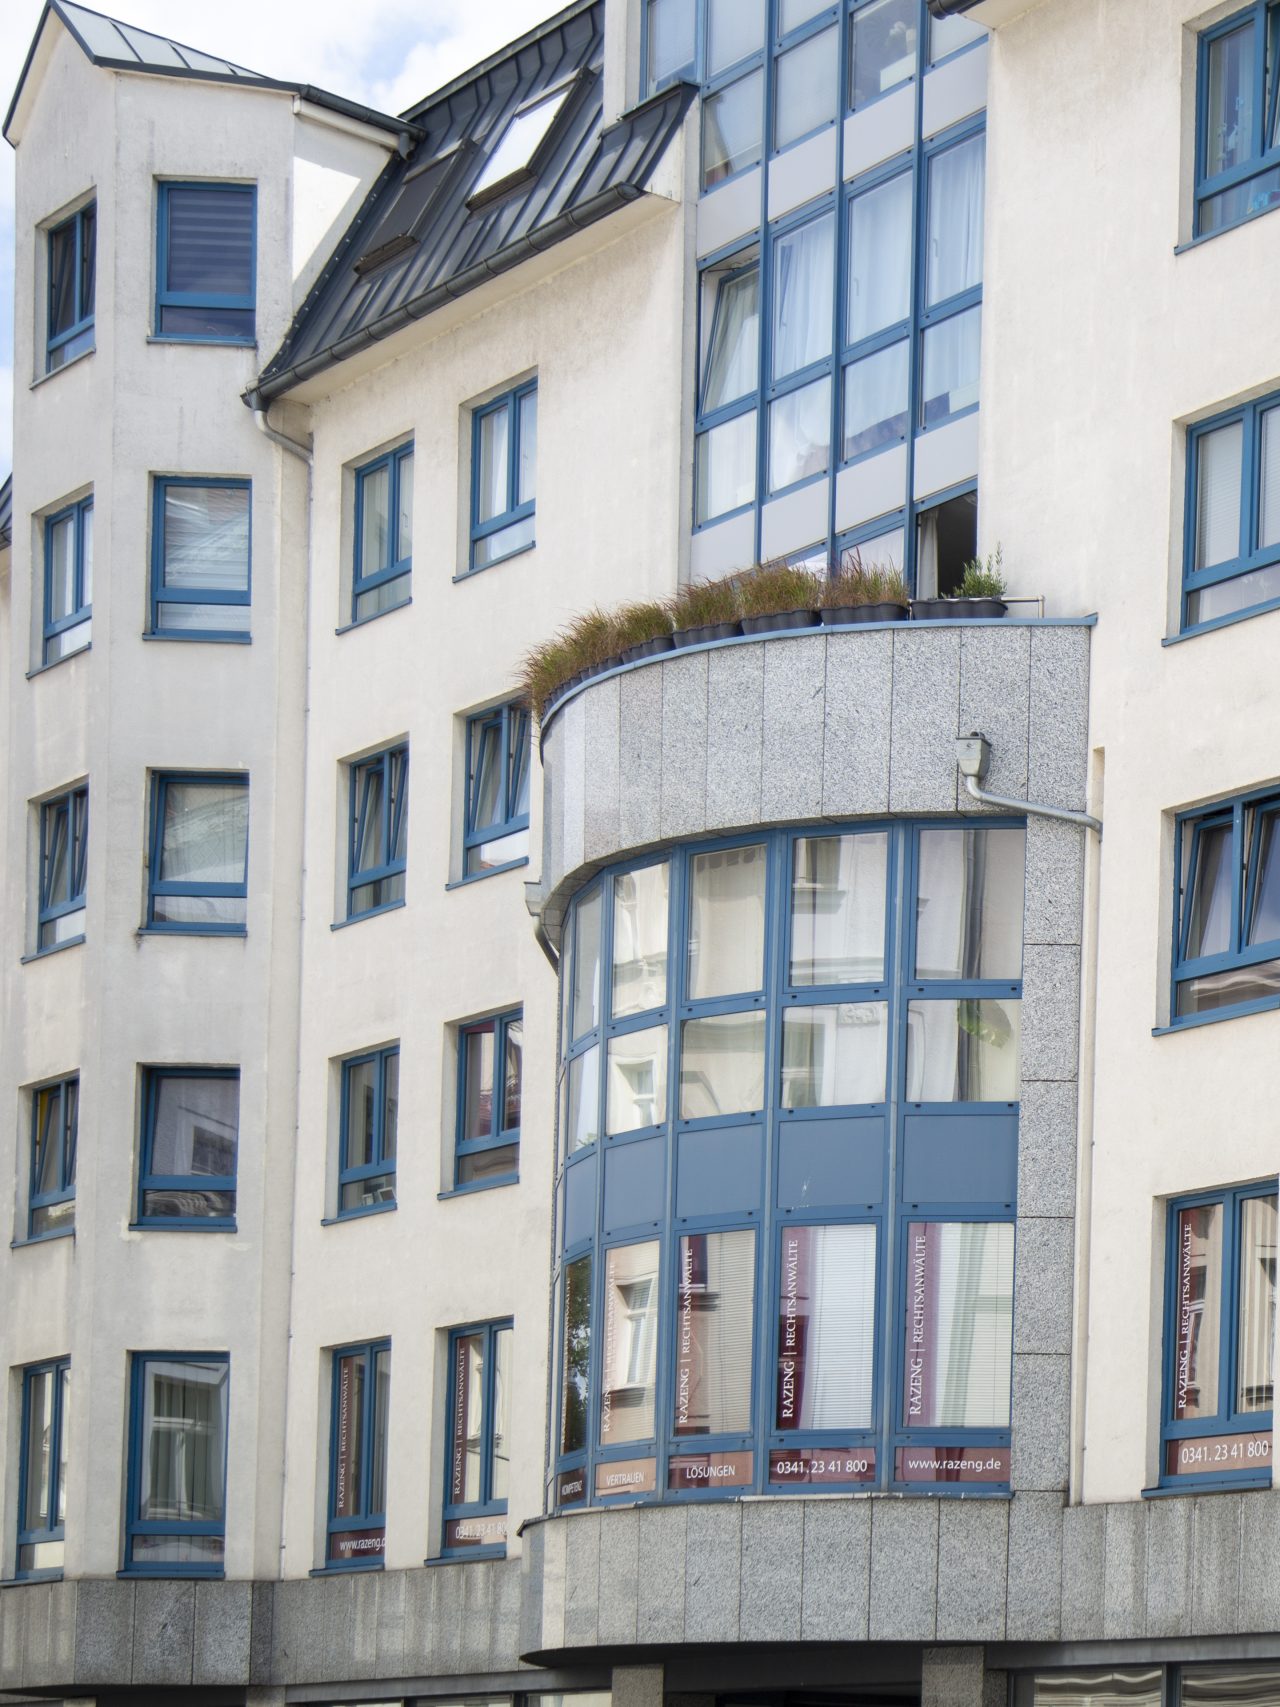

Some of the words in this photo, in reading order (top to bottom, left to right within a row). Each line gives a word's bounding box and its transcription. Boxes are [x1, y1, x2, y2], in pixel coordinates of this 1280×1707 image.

[682, 1248, 693, 1354] RECHTSANWÄLTE
[786, 1240, 798, 1347] RECHTSANWÄLTE
[913, 1235, 926, 1344] RECHTSANWÄLTE
[1181, 1223, 1192, 1334] RECHTSANWÄLTE
[678, 1368, 689, 1424] RAZENG
[782, 1361, 795, 1418] RAZENG
[910, 1358, 923, 1415] RAZENG
[1178, 1350, 1189, 1409] RAZENG
[686, 1463, 736, 1478] LÖSUNGEN
[828, 1460, 841, 1472] 41
[846, 1460, 868, 1472] 800
[908, 1458, 1002, 1472] www.razeng.de
[1230, 1443, 1243, 1459] 41
[1248, 1440, 1269, 1458] 800
[606, 1472, 645, 1486] VERTRAUEN
